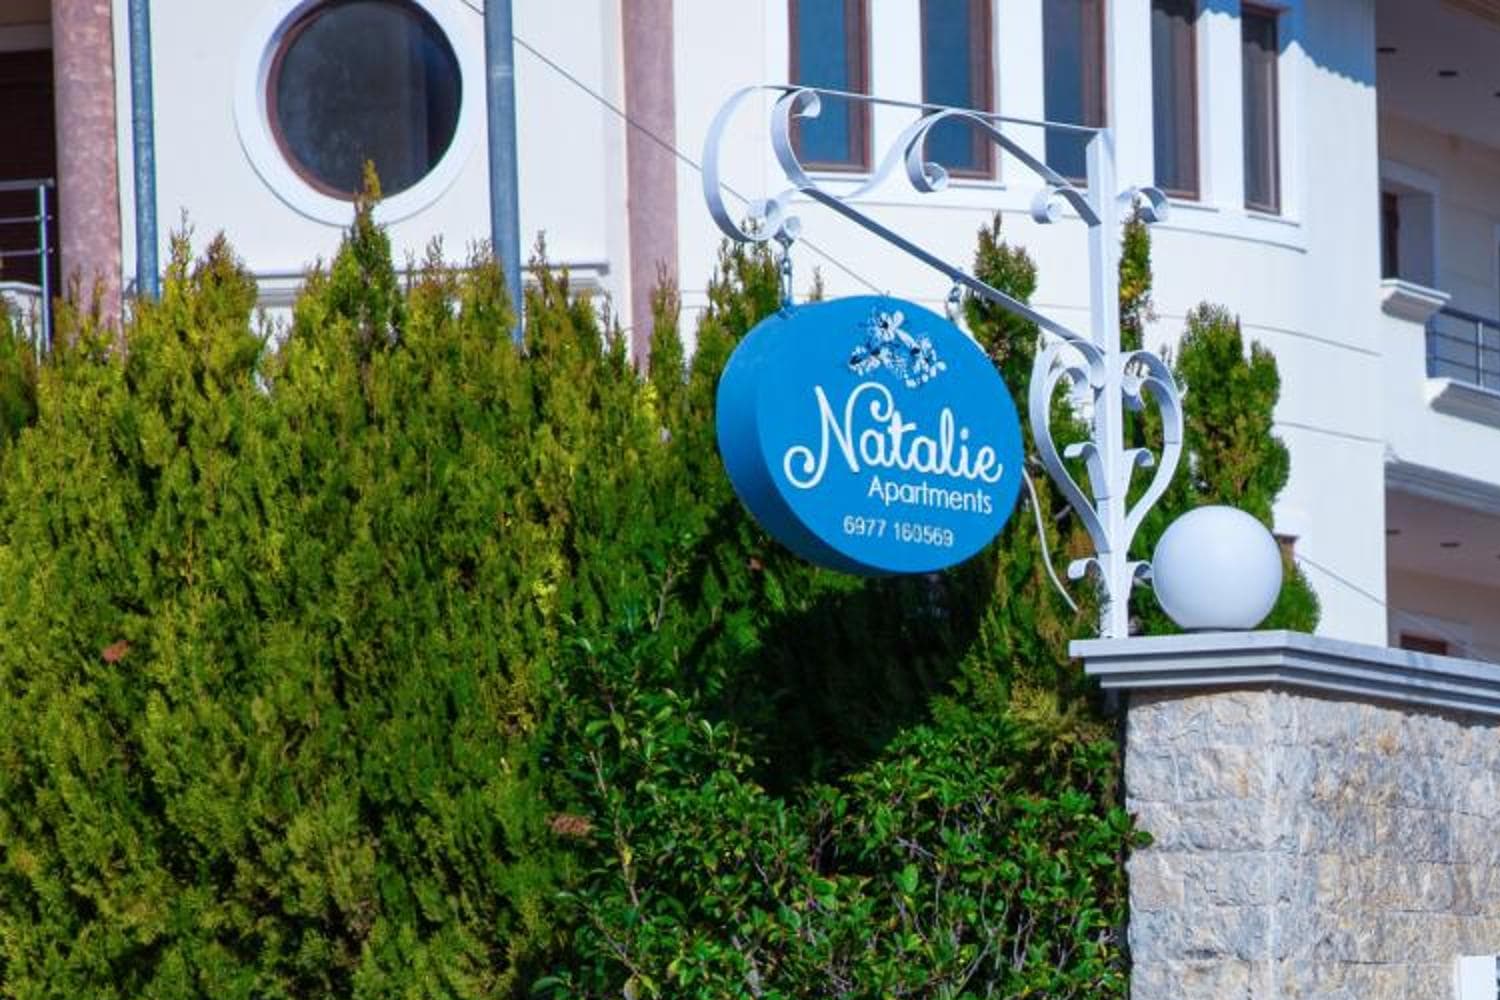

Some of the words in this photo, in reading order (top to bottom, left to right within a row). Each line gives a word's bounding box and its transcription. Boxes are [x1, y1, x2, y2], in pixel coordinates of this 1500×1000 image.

[783, 382, 1003, 489] Natalie
[867, 476, 993, 514] Apartments
[843, 515, 886, 537] 6977
[894, 522, 954, 547] 160569
